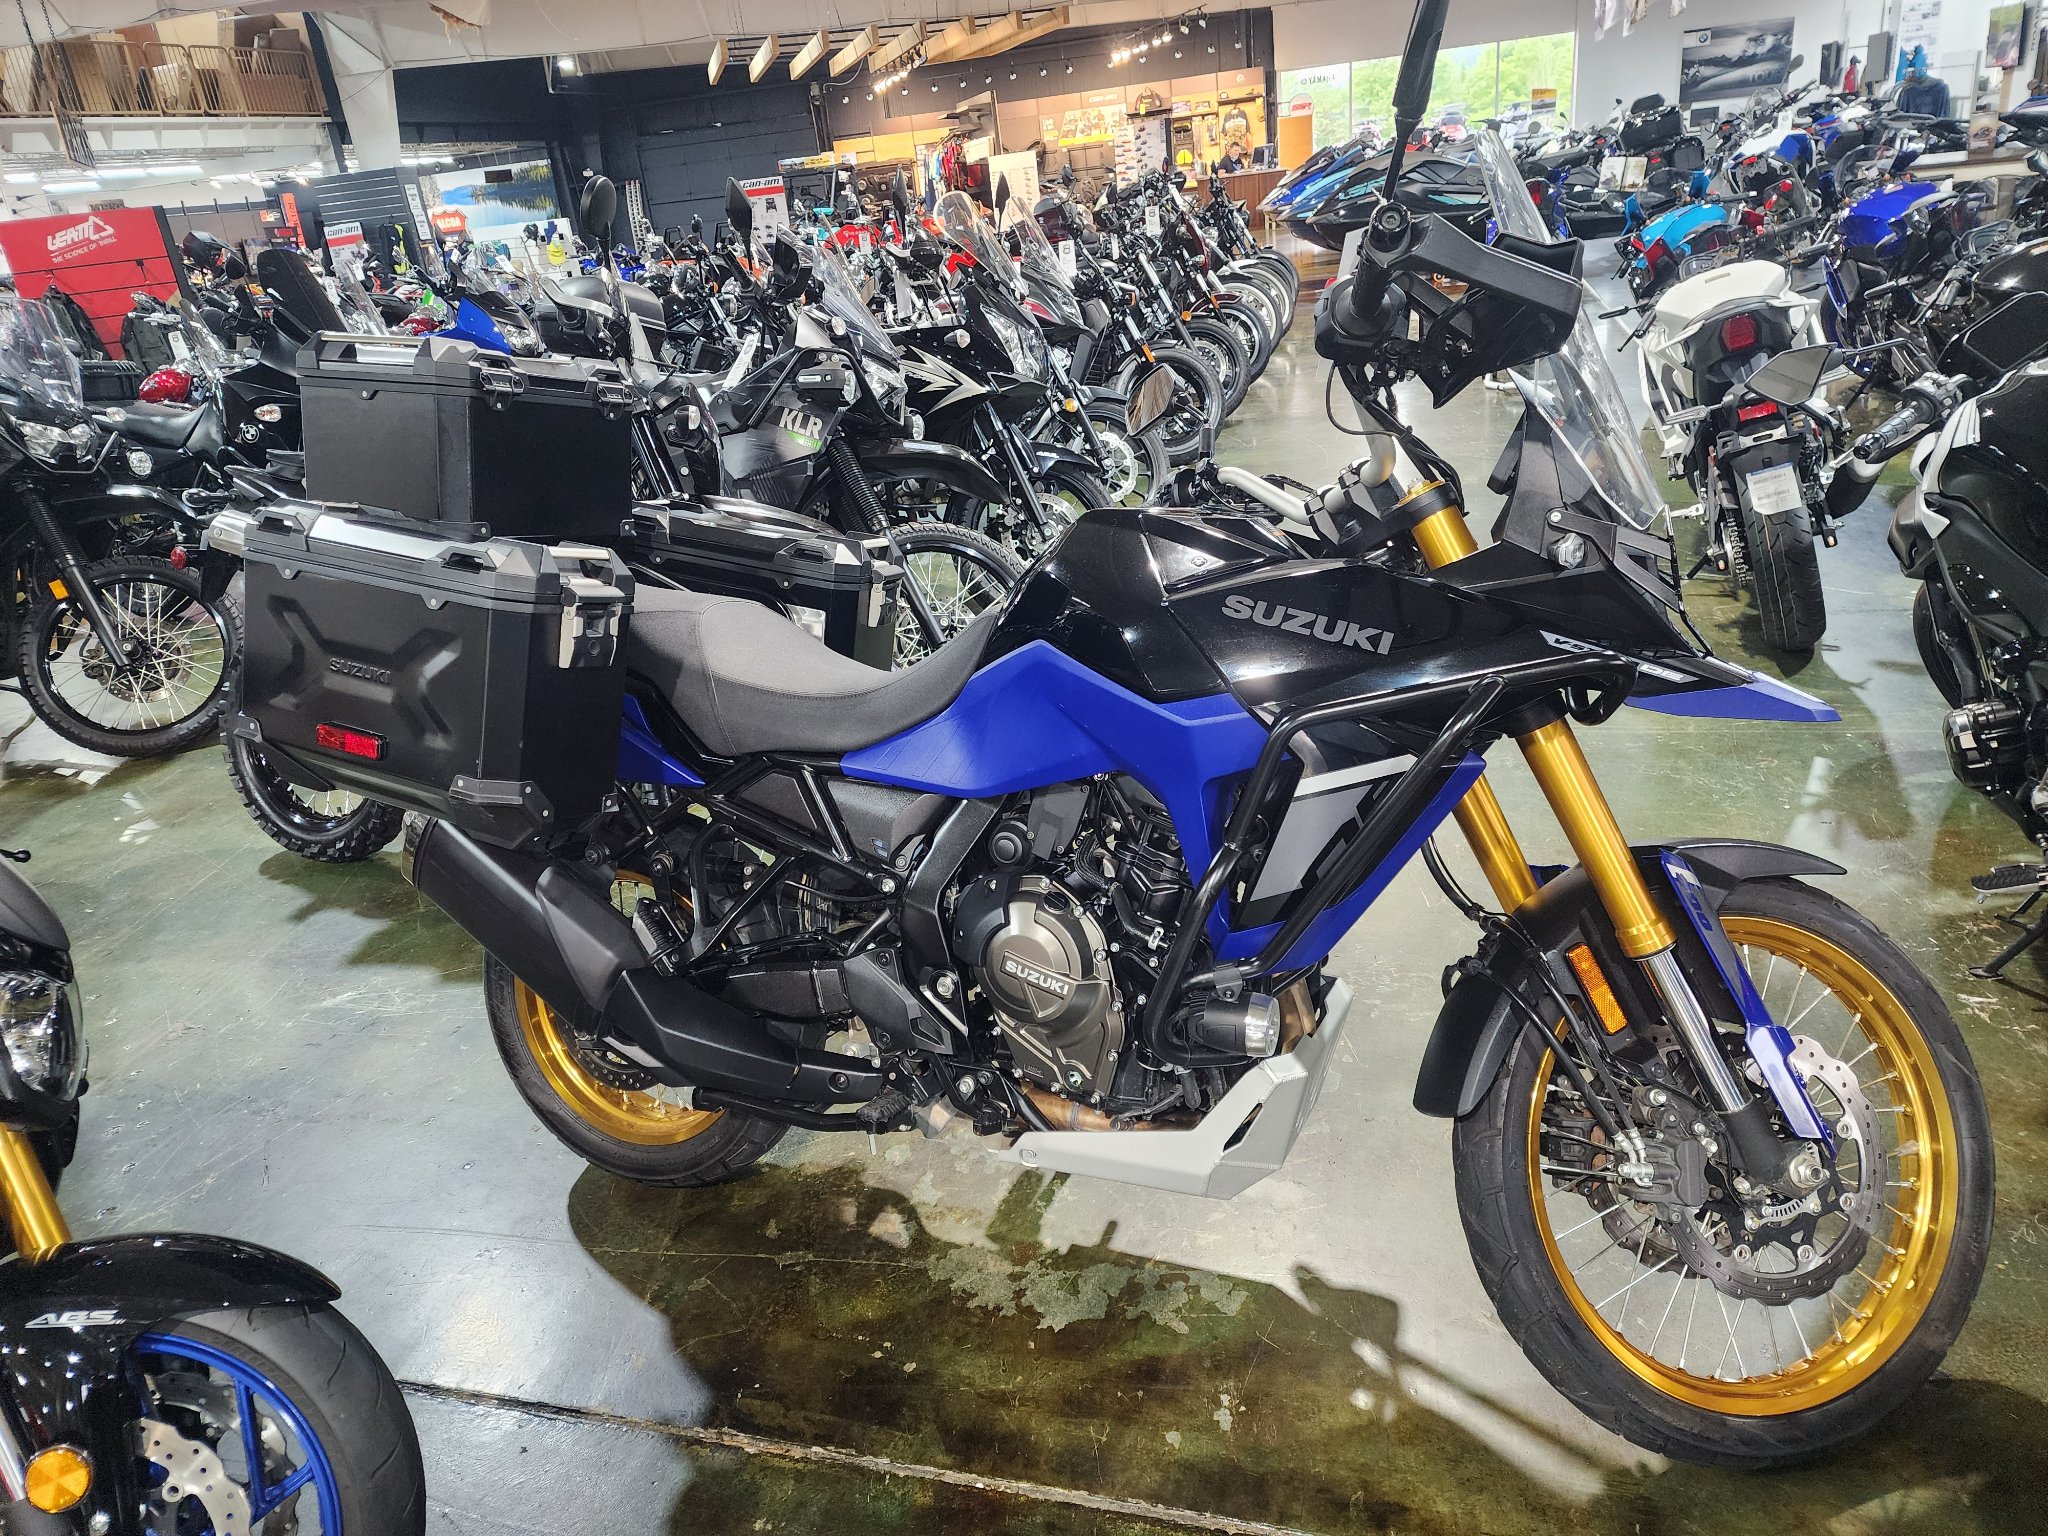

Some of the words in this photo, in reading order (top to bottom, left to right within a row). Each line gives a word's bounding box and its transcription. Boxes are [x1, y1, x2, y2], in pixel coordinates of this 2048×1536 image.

[743, 178, 780, 189] can-am
[327, 225, 359, 237] can-am
[52, 255, 64, 263] THE
[64, 246, 88, 260] SCIENCE
[89, 242, 97, 251] OF
[98, 236, 117, 247] THRILL
[780, 407, 823, 440] KLR
[1221, 594, 1395, 655] SUZUKI
[329, 657, 391, 684] SUZUKI
[1639, 663, 1687, 682] DE
[1005, 960, 1069, 995] SUZUKI
[24, 1310, 120, 1328] ABS
